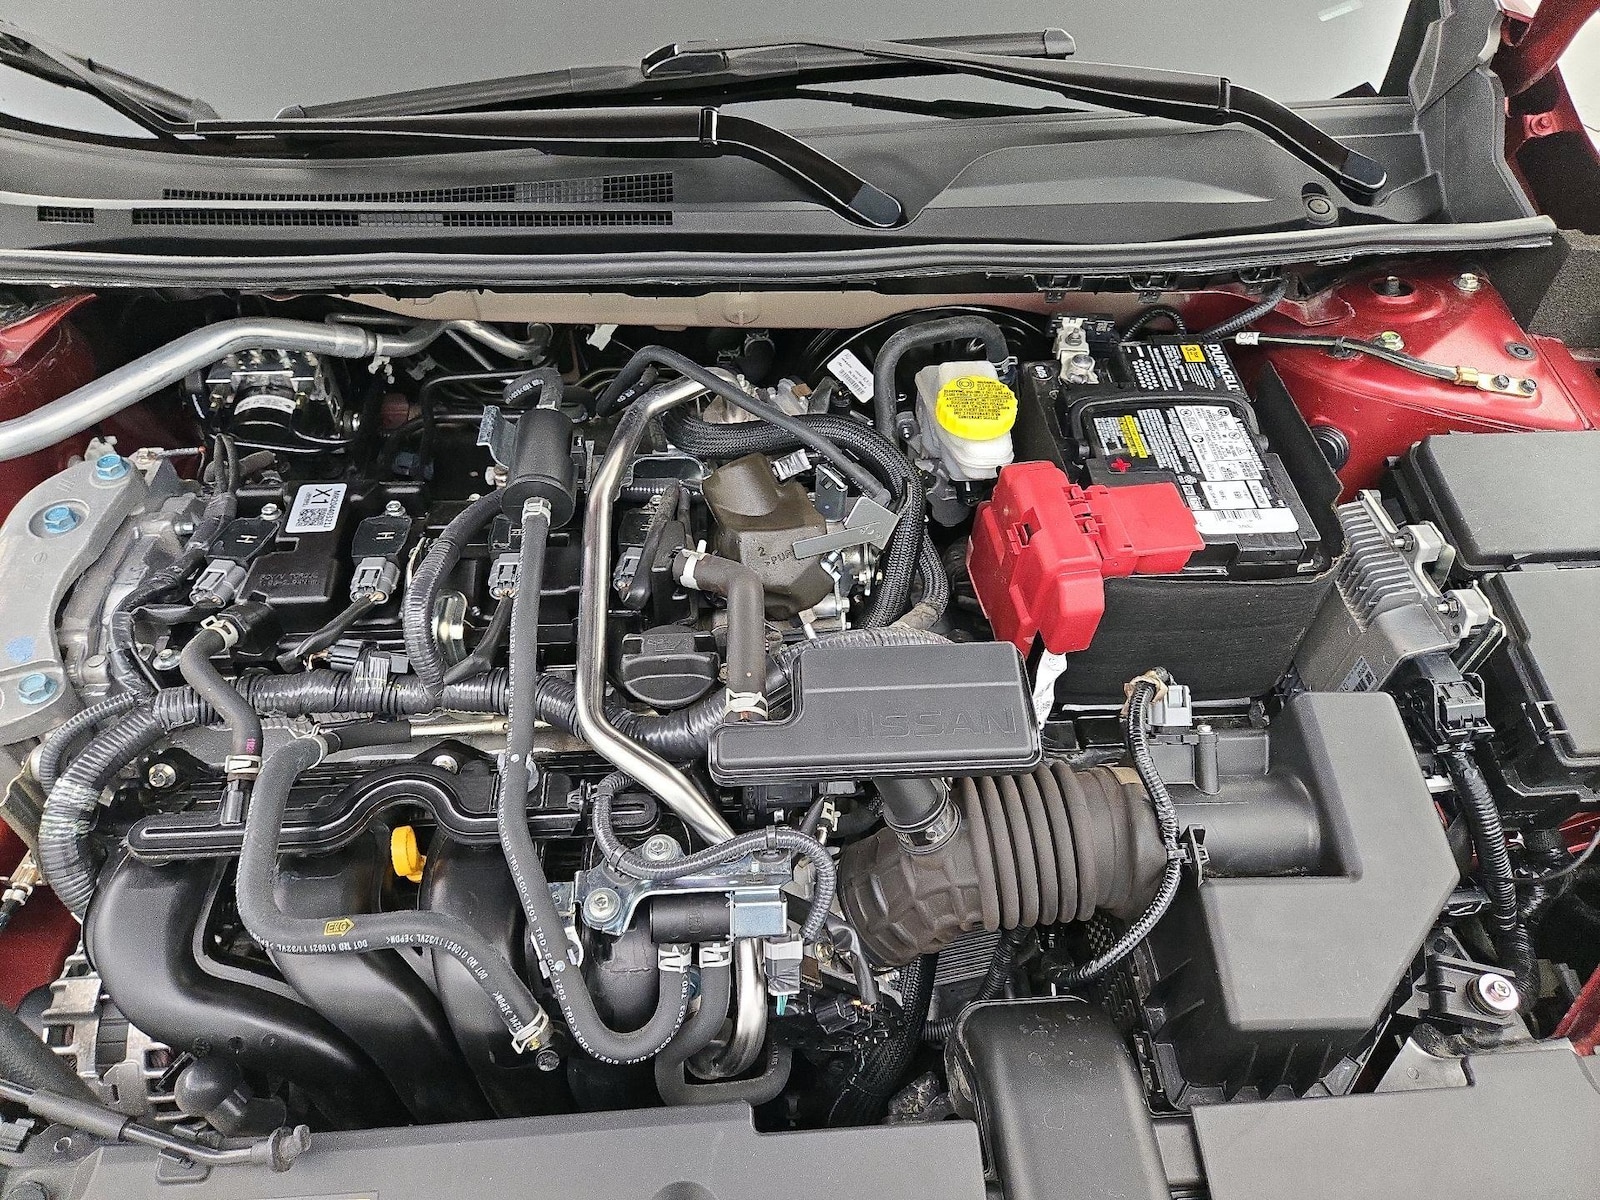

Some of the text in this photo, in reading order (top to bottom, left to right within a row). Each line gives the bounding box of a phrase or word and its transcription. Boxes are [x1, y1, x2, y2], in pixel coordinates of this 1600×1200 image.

[1208, 343, 1241, 391] DURACELL
[311, 488, 333, 504] X1
[829, 707, 1017, 739] NISSAN
[353, 939, 368, 949] DOT
[443, 939, 468, 958] 010821
[474, 966, 488, 980] DOT
